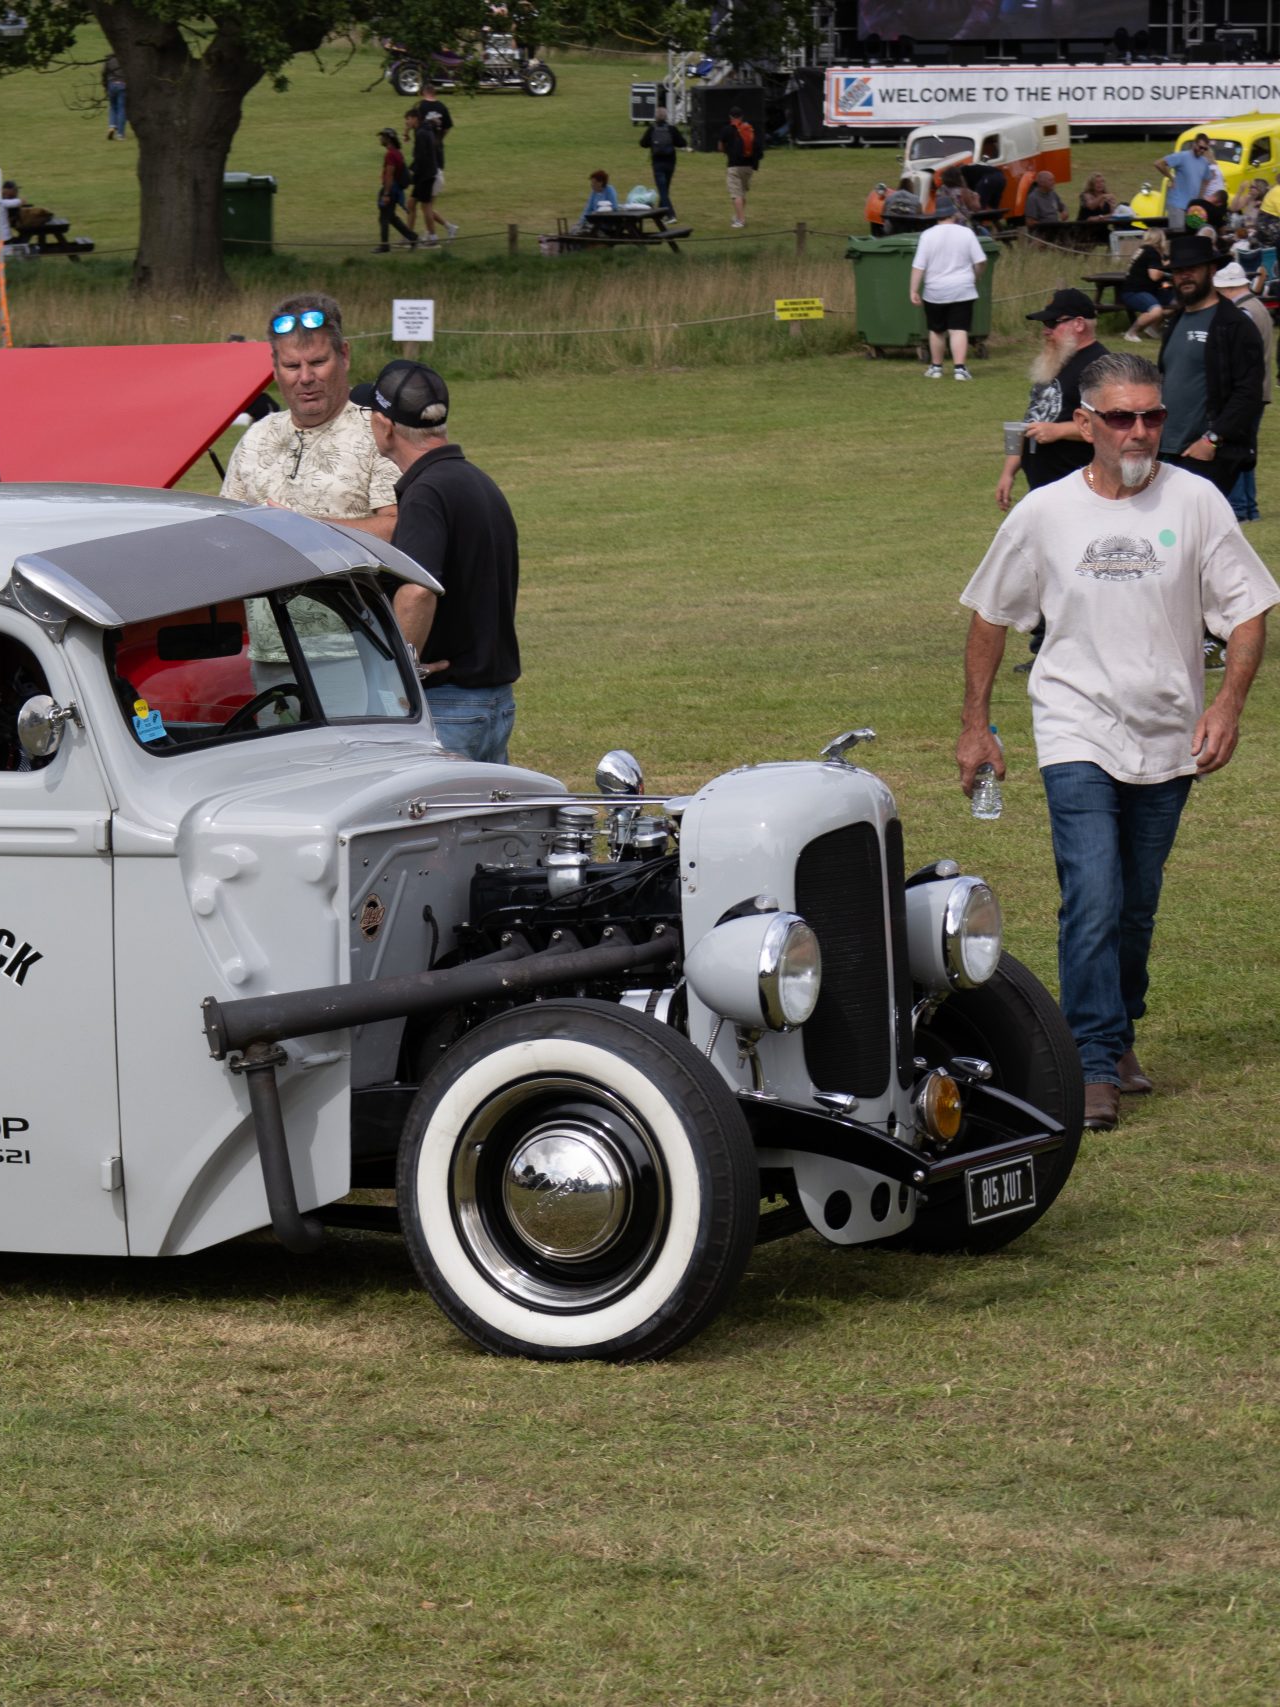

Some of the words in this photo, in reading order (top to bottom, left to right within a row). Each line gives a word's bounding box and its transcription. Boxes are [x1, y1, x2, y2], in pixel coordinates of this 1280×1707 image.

[879, 87, 977, 103] WELCOME
[982, 87, 1009, 102] TO
[1015, 86, 1052, 101] THE
[1058, 86, 1097, 101] HOT
[1103, 86, 1145, 101] ROD
[982, 1176, 999, 1208] 815
[1002, 1170, 1021, 1203] XUT
